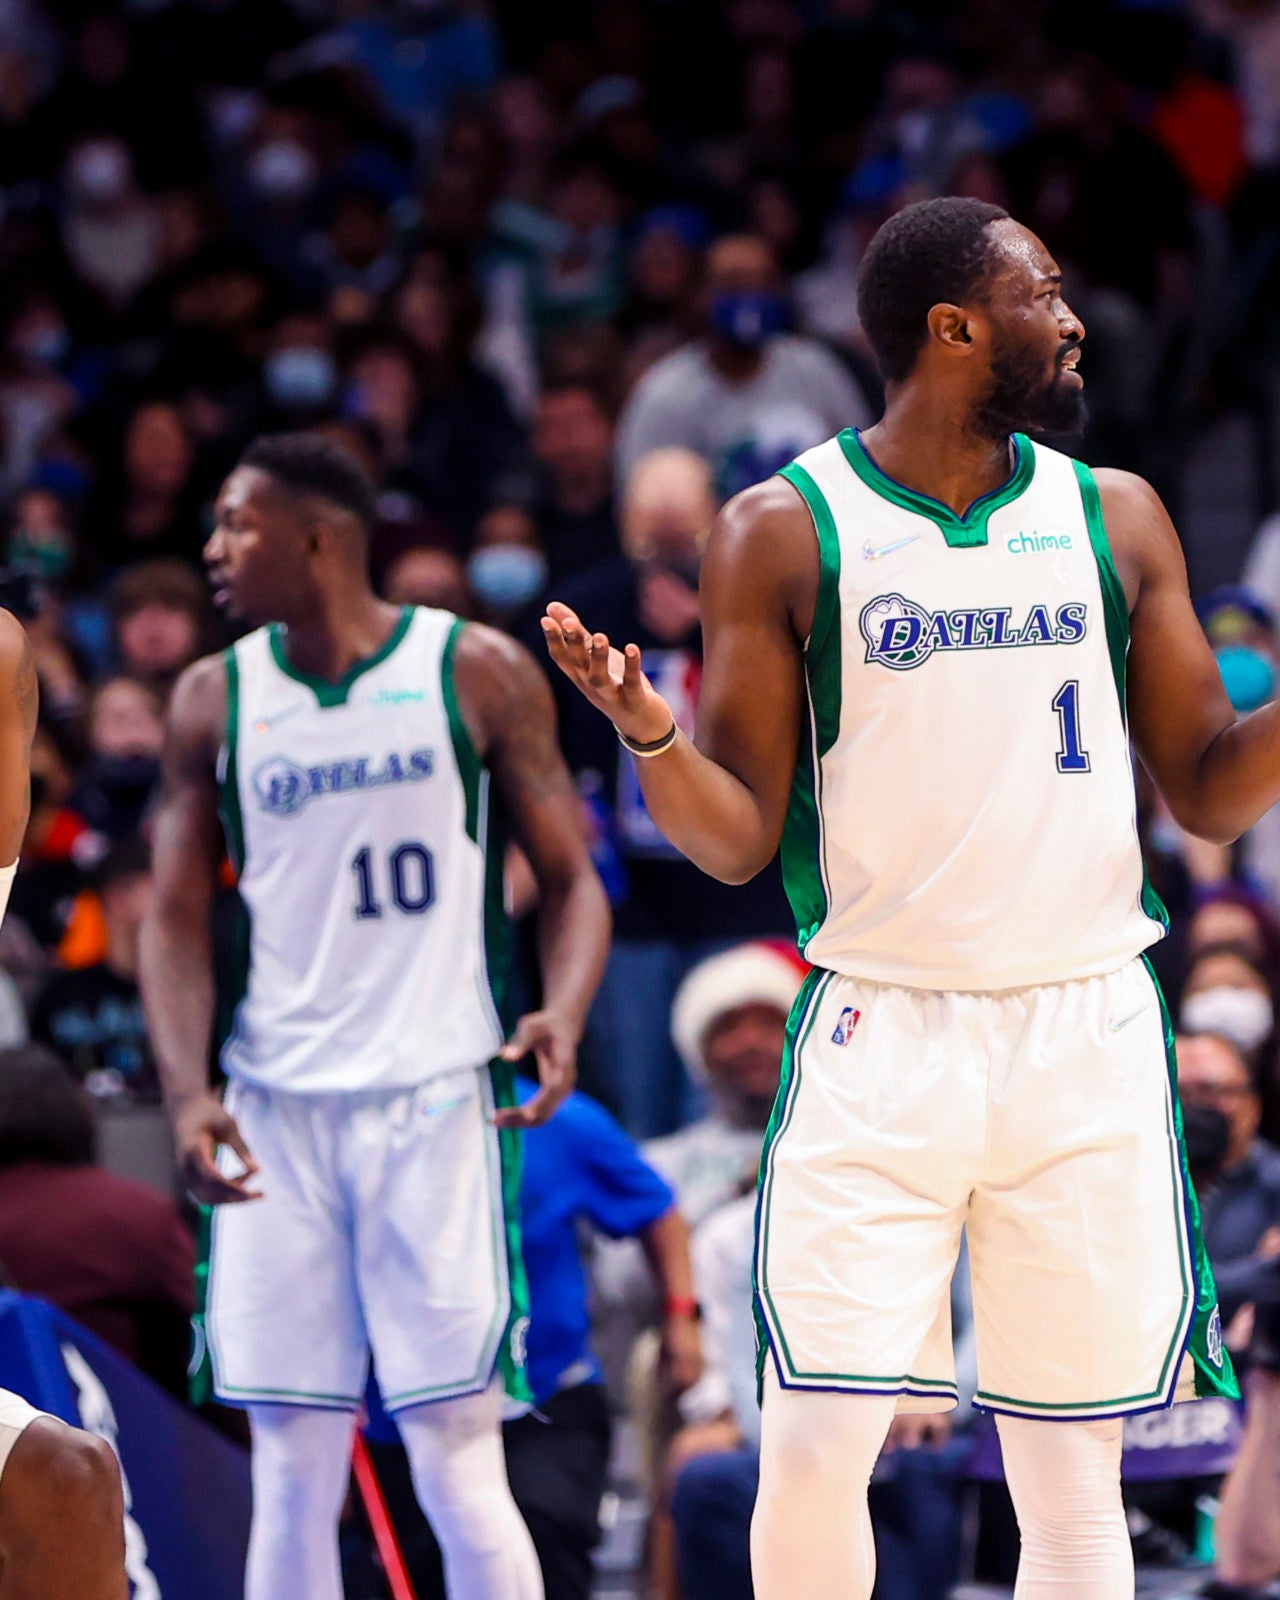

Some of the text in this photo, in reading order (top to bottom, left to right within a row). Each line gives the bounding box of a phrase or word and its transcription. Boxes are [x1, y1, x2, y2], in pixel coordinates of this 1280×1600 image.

[1007, 530, 1073, 554] chime
[864, 602, 1087, 664] DALLAS
[1051, 680, 1091, 773] 1
[352, 842, 436, 919] 10
